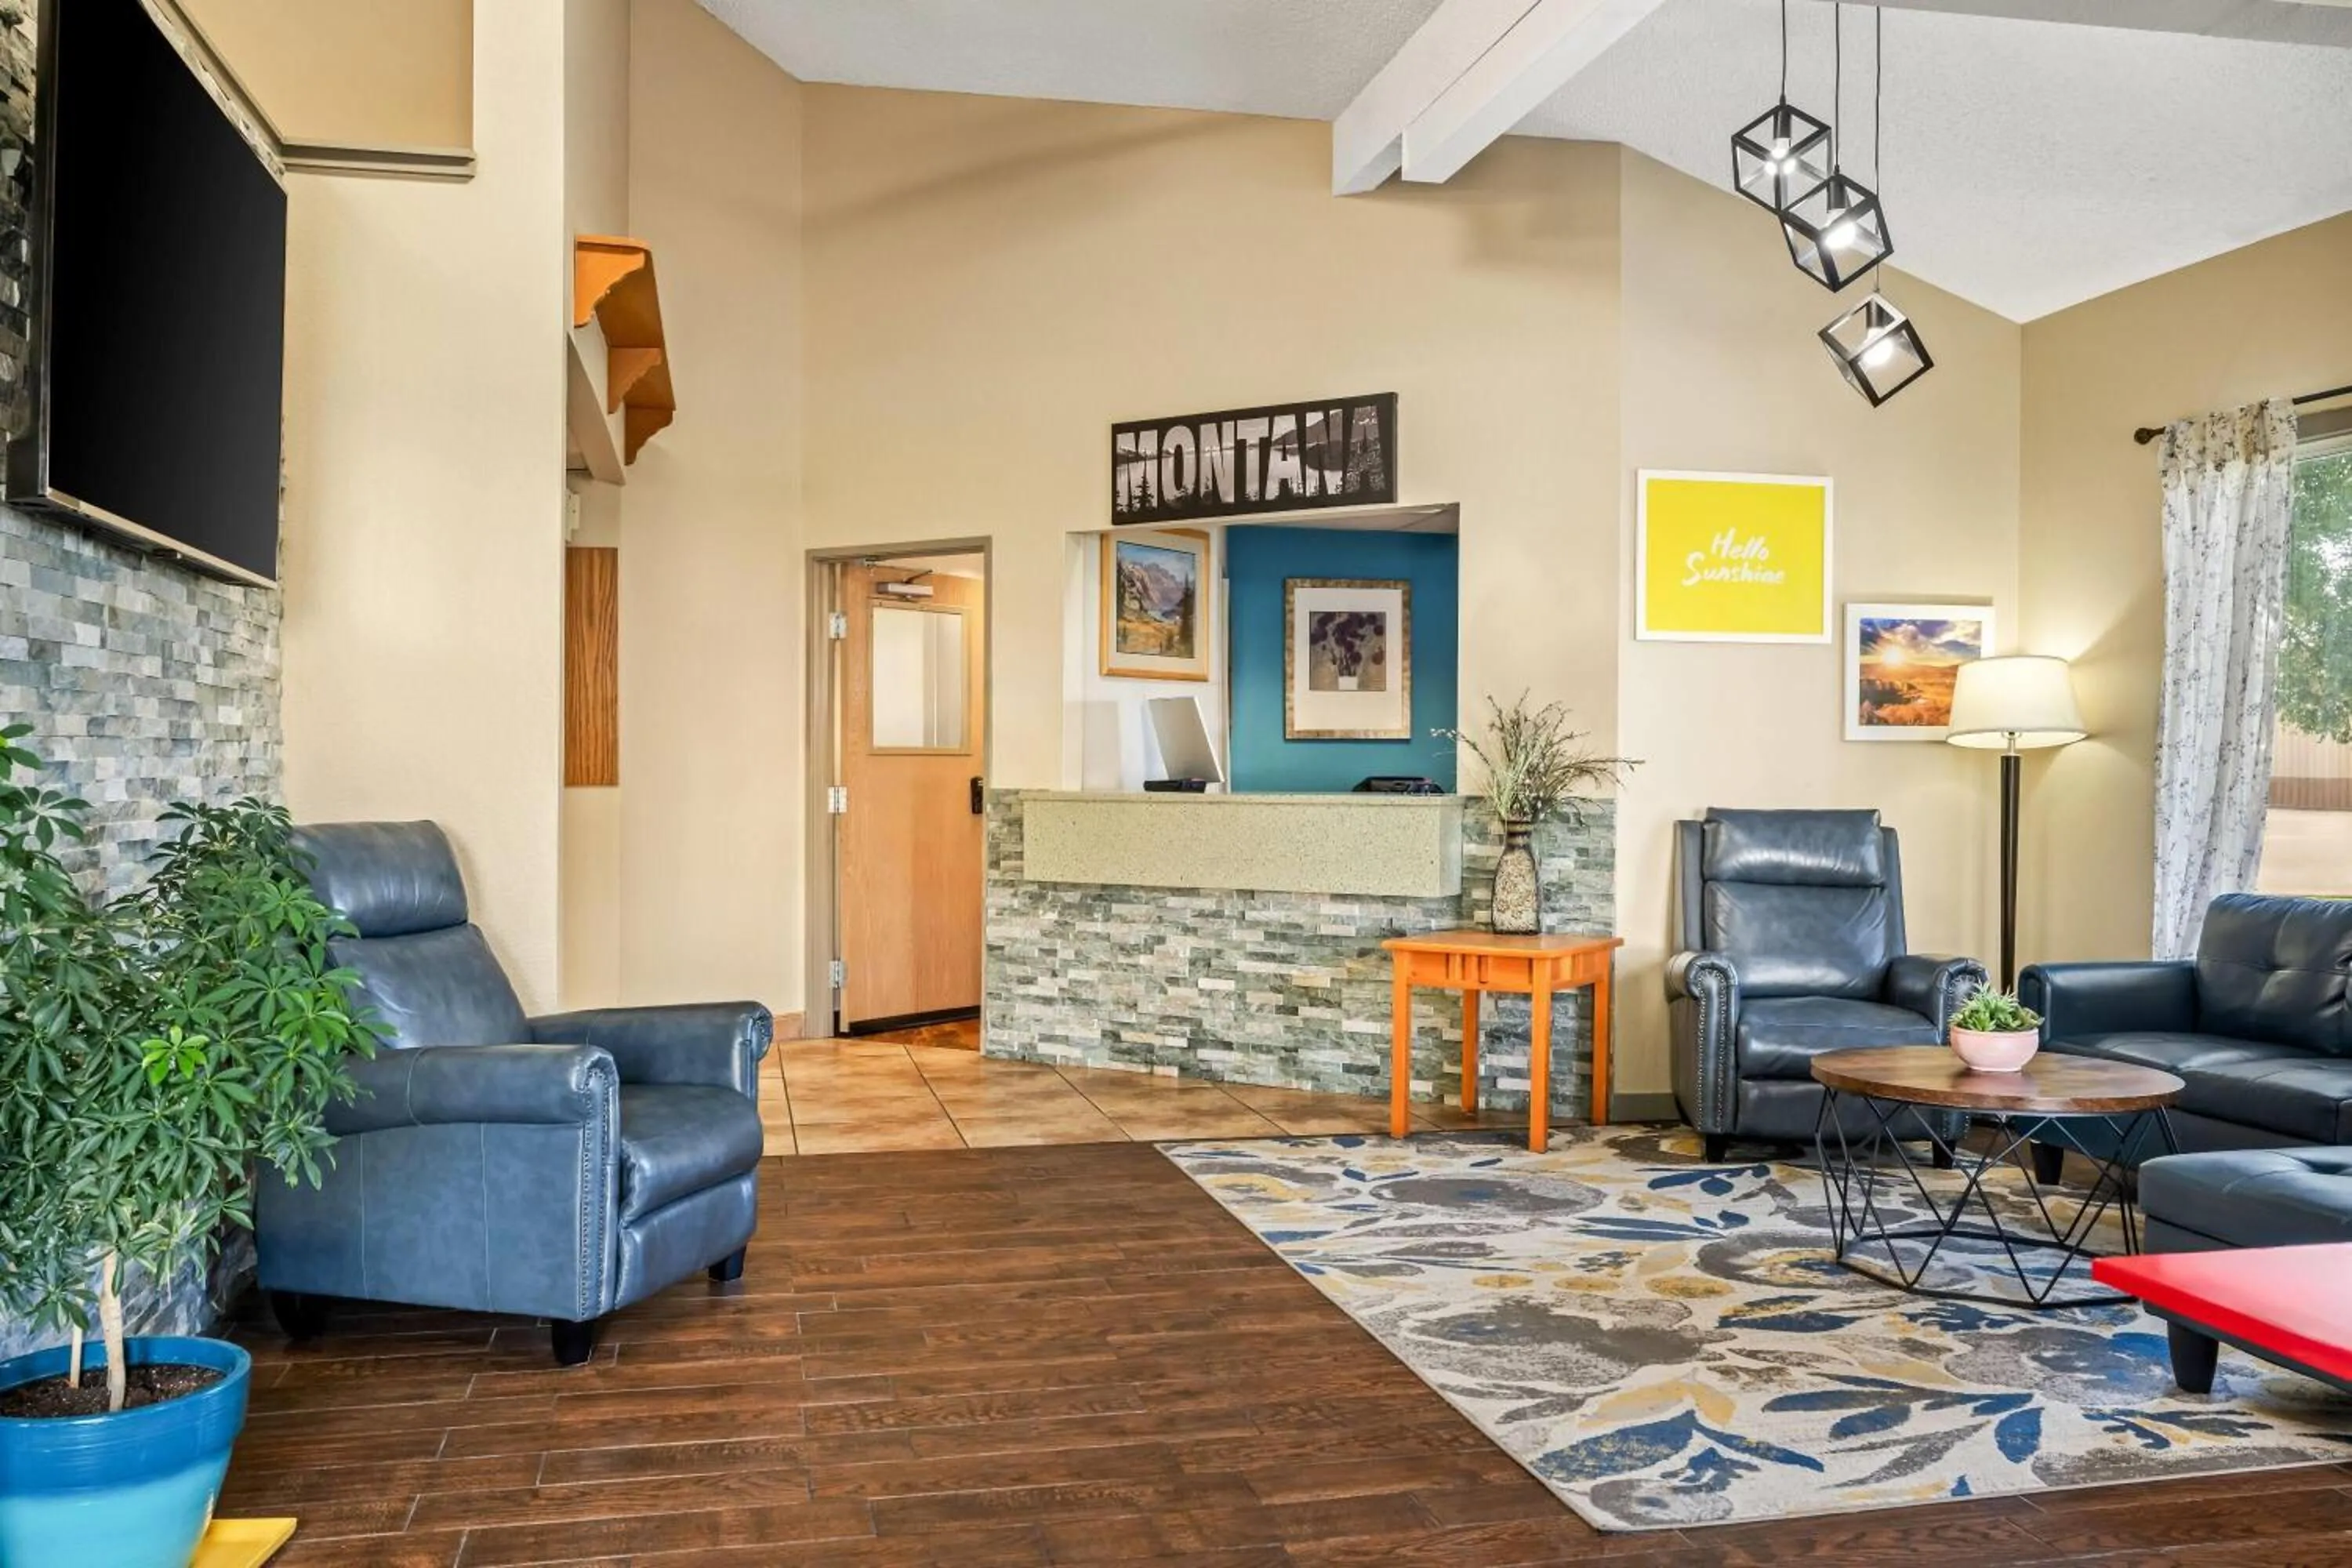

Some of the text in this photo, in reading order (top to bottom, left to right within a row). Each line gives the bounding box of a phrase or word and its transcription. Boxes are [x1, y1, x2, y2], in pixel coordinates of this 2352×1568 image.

[1116, 405, 1386, 514] MONTANA
[1711, 526, 1769, 561] Hello
[1681, 551, 1786, 586] Sunshine
